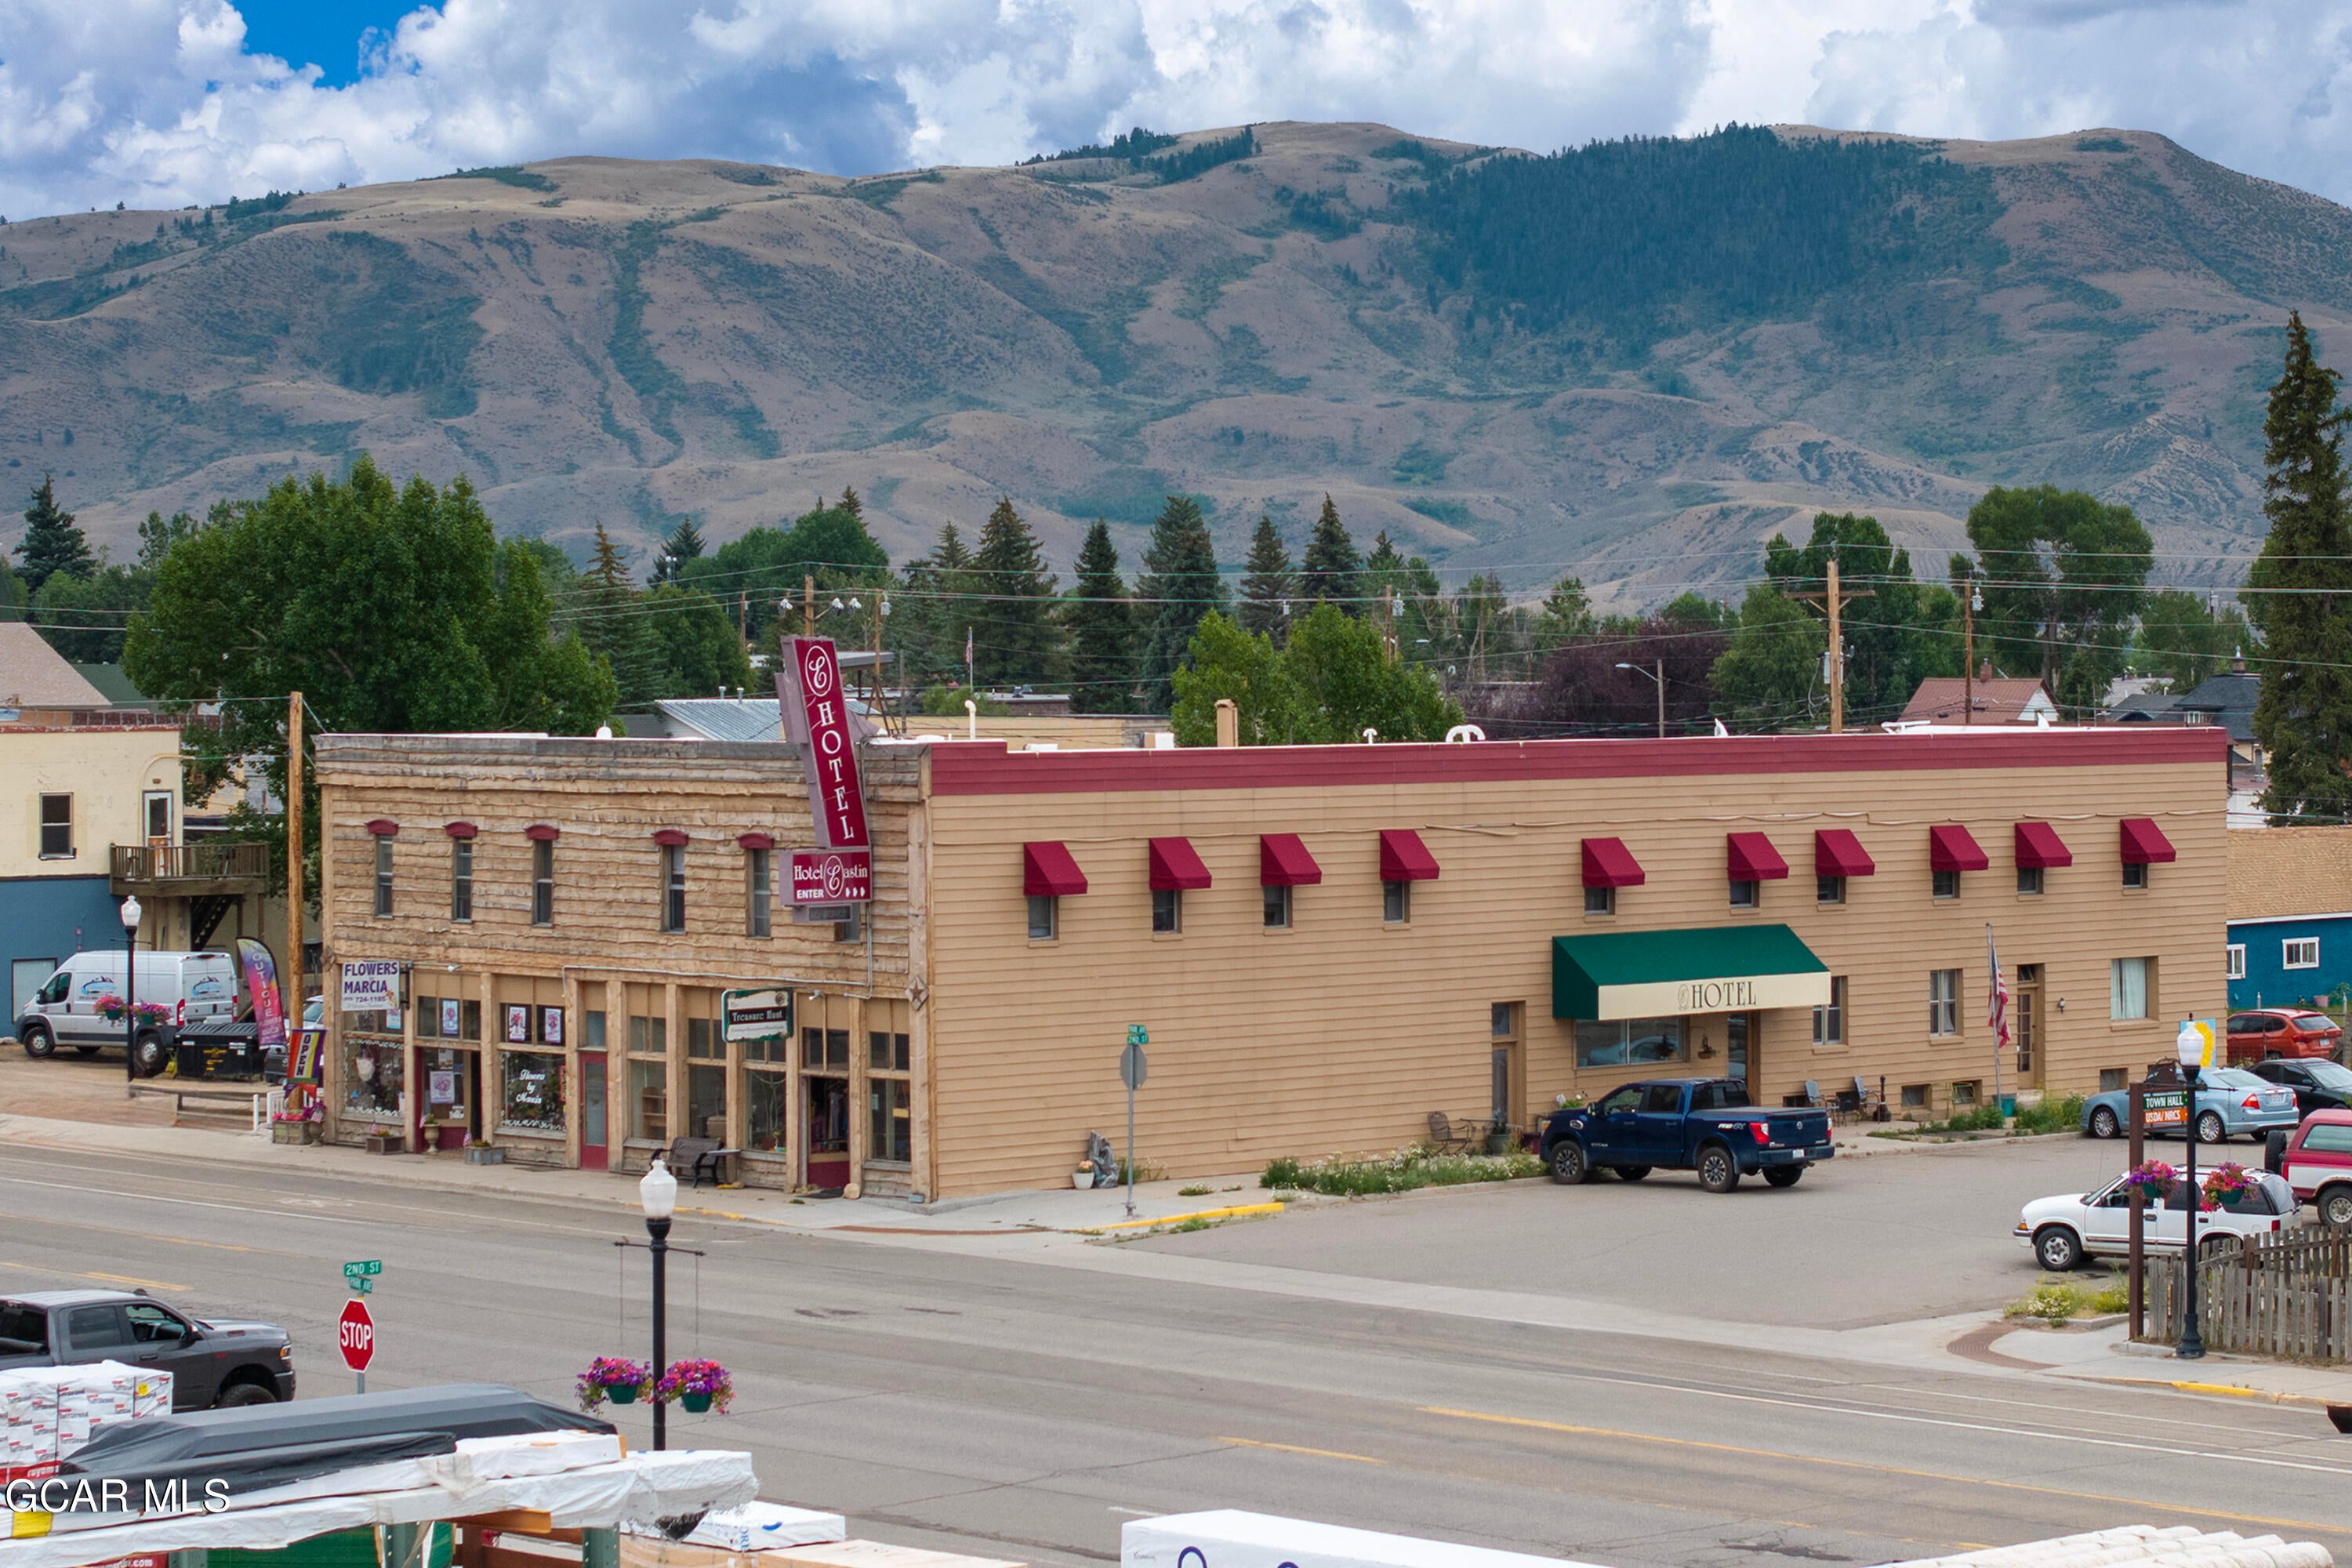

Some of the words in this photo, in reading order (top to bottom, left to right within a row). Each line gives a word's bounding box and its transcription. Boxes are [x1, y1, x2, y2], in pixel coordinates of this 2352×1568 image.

[817, 701, 854, 840] HOTEL
[794, 864, 824, 880] Hotel
[797, 889, 824, 899] ENTER
[344, 962, 397, 976] FLOWERS
[344, 980, 387, 994] MARCIA
[1691, 981, 1756, 1008] HOTEL
[732, 1012, 764, 1022] Treasure
[296, 1035, 311, 1076] OPEN
[527, 1082, 536, 1094] by
[2146, 1097, 2166, 1108] TOWN
[2167, 1096, 2183, 1106] HALL
[346, 1263, 365, 1276] 2ND
[369, 1261, 381, 1272] ST
[341, 1320, 372, 1350] STOP
